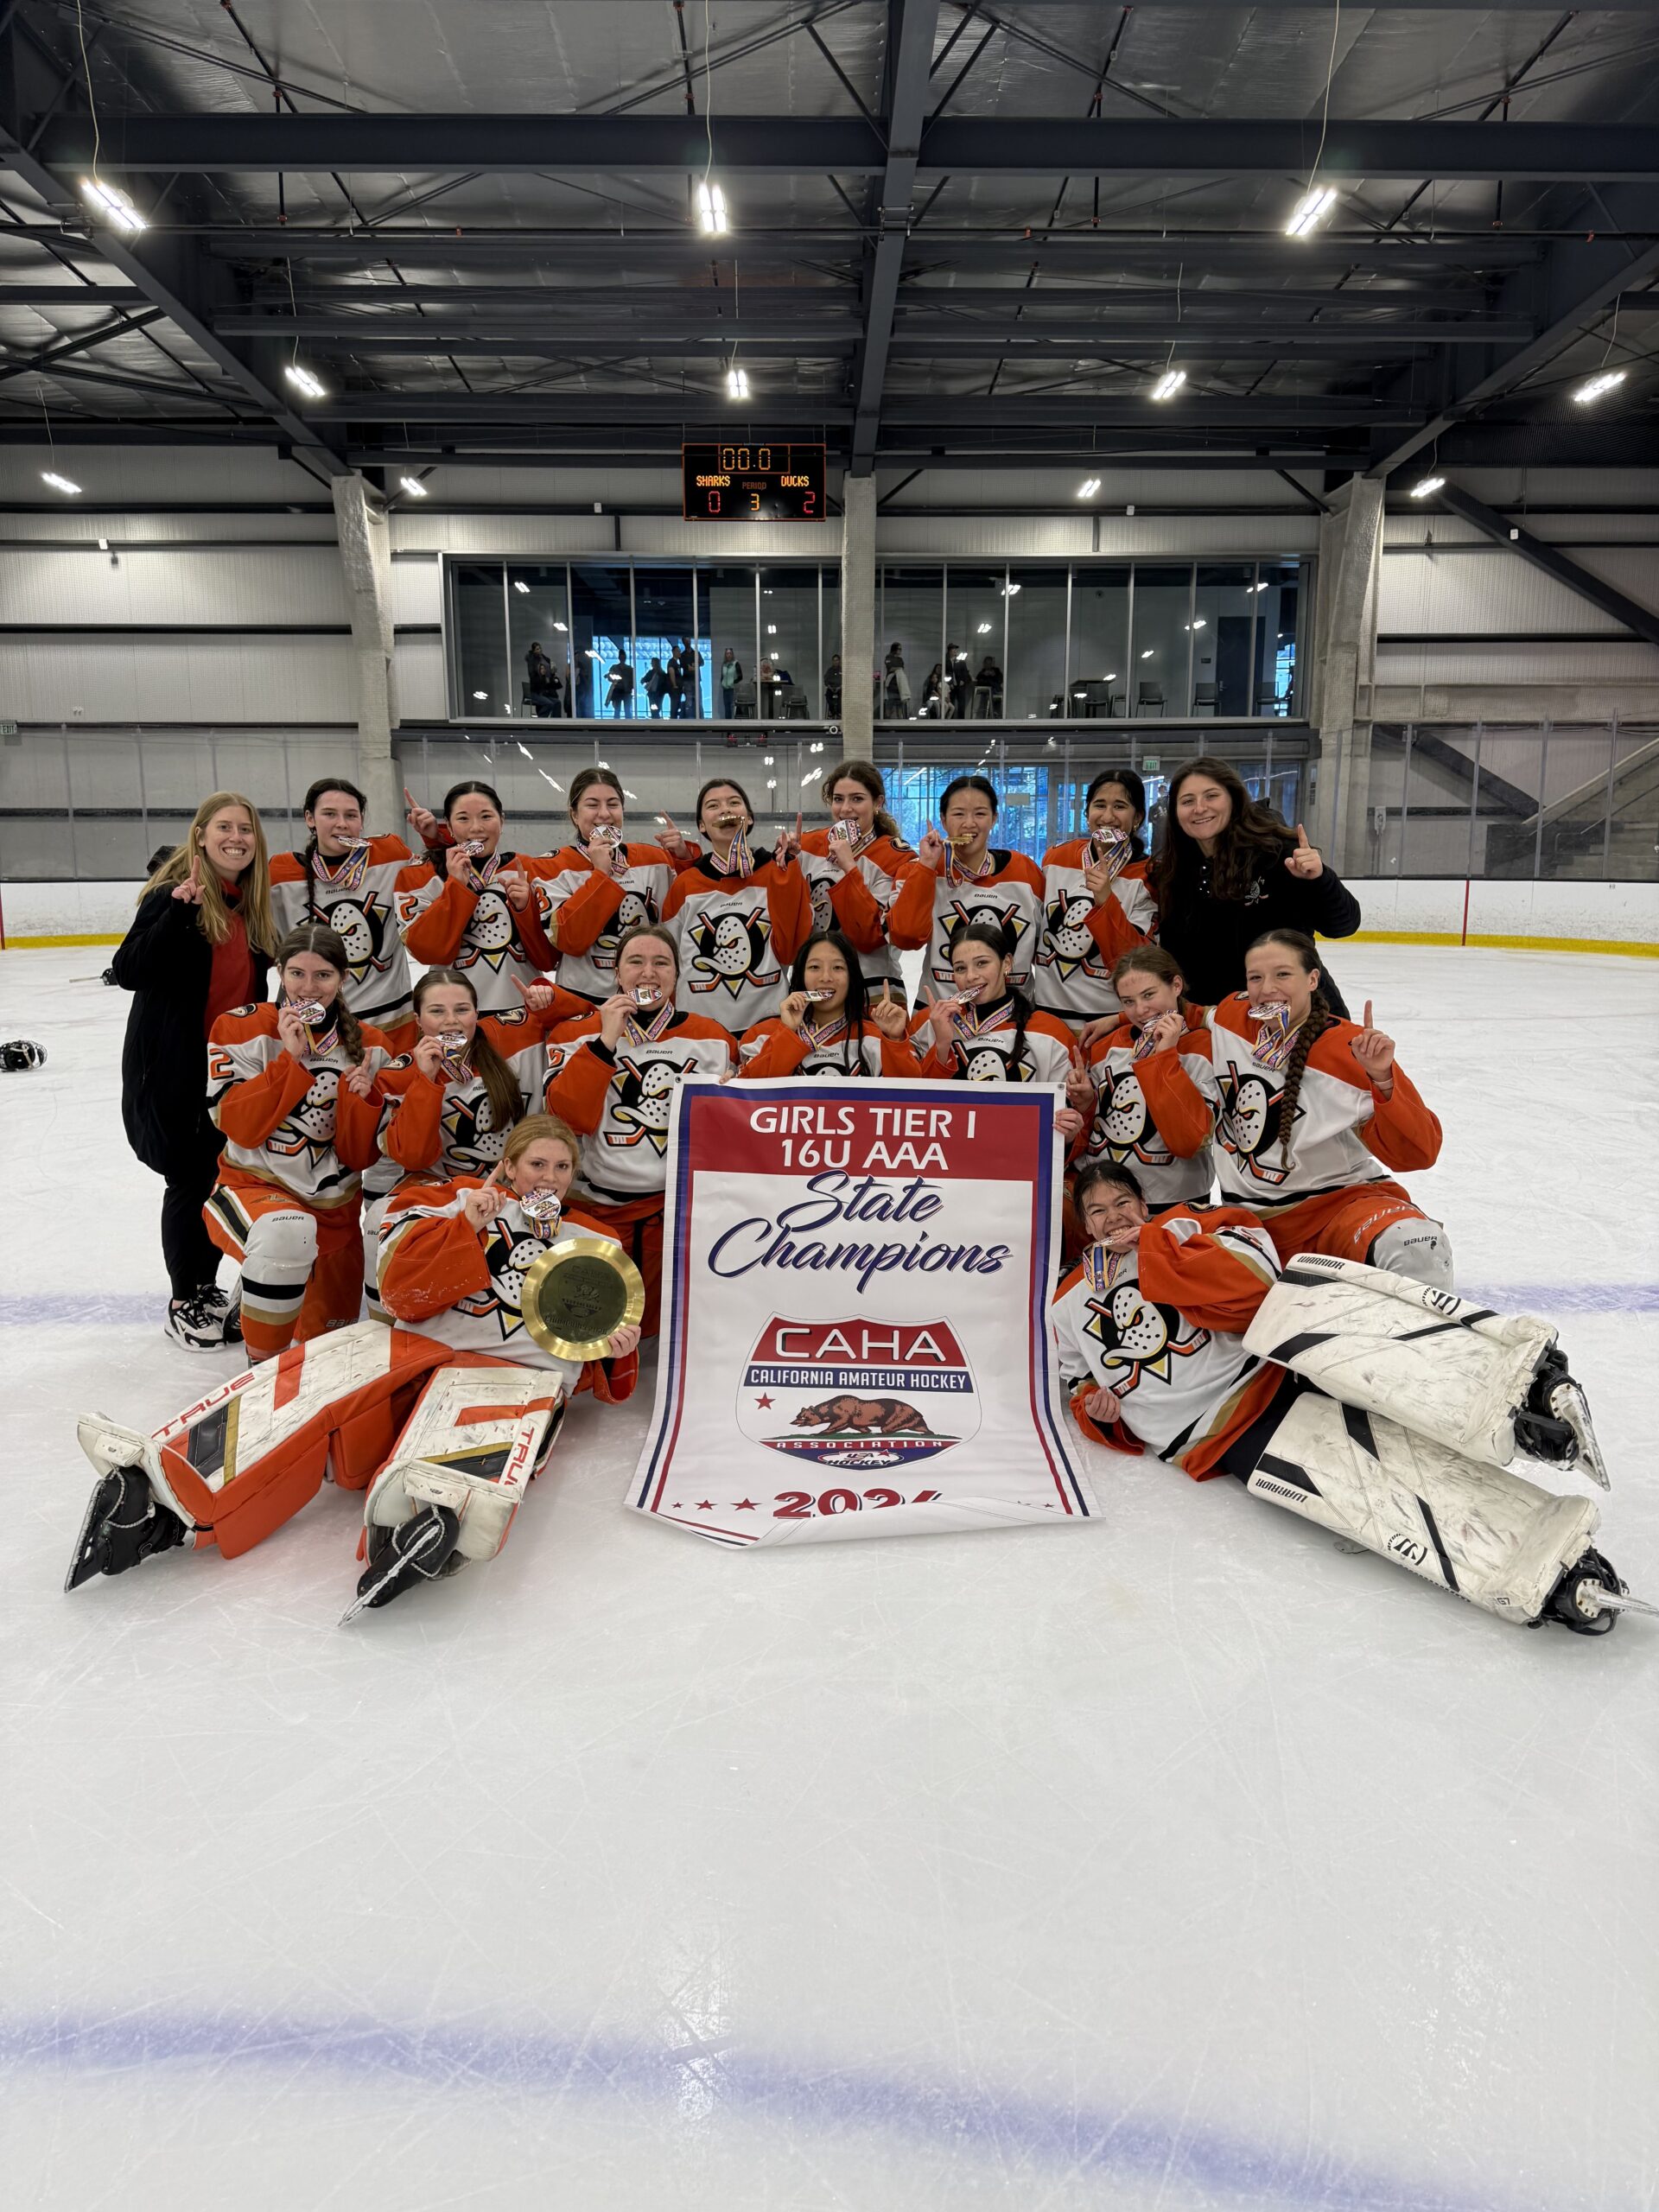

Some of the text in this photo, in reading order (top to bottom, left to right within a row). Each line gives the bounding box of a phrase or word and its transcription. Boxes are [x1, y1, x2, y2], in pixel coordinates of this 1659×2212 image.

[696, 475, 731, 487] SHARKS
[741, 481, 766, 491] PERIOD
[780, 475, 810, 487] DUCKS
[709, 490, 721, 513] 0
[750, 493, 760, 512] 3
[803, 491, 816, 514] 2
[750, 1106, 976, 1139] GIRLS TIER I
[781, 1139, 949, 1171] 16U AAA
[777, 1169, 944, 1233] State
[1403, 1236, 1438, 1247] BAUER
[708, 1217, 1014, 1294] Champions
[1296, 1255, 1346, 1270] WARRIOR
[776, 1327, 947, 1362] CAHA
[750, 1369, 966, 1389] CALIFORNIA AMATEUR HOCKEY
[151, 1371, 255, 1439] TRUE
[504, 1427, 535, 1485] TRU
[777, 1440, 944, 1450] ASSOCIATION
[1255, 1478, 1309, 1503] WARRIOR
[772, 1488, 943, 1520] 202
